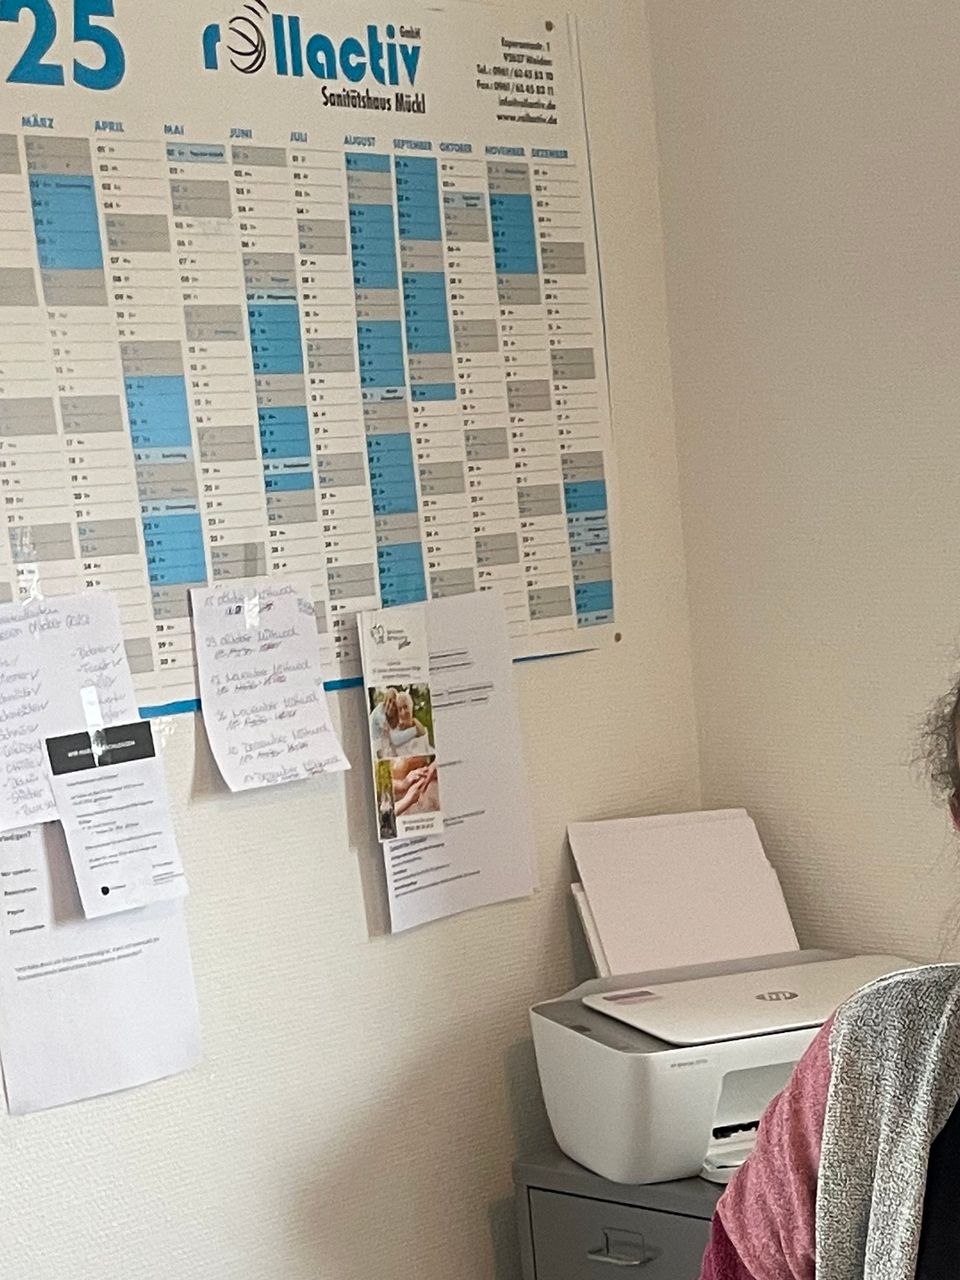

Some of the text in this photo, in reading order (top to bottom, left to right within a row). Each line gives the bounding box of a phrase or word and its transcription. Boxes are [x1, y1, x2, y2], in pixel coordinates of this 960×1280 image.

[321, 86, 392, 111] Sanitätshaus
[21, 113, 54, 129] MÄRZ
[95, 120, 124, 133] APRIL
[164, 124, 184, 135] MAI
[229, 128, 252, 139] JUNI
[290, 132, 307, 142] JULI
[344, 136, 375, 147] AUGUST
[393, 139, 432, 151] SEPTEMBER
[440, 142, 472, 153] OKTOBER
[485, 146, 525, 157] NOVEMBER
